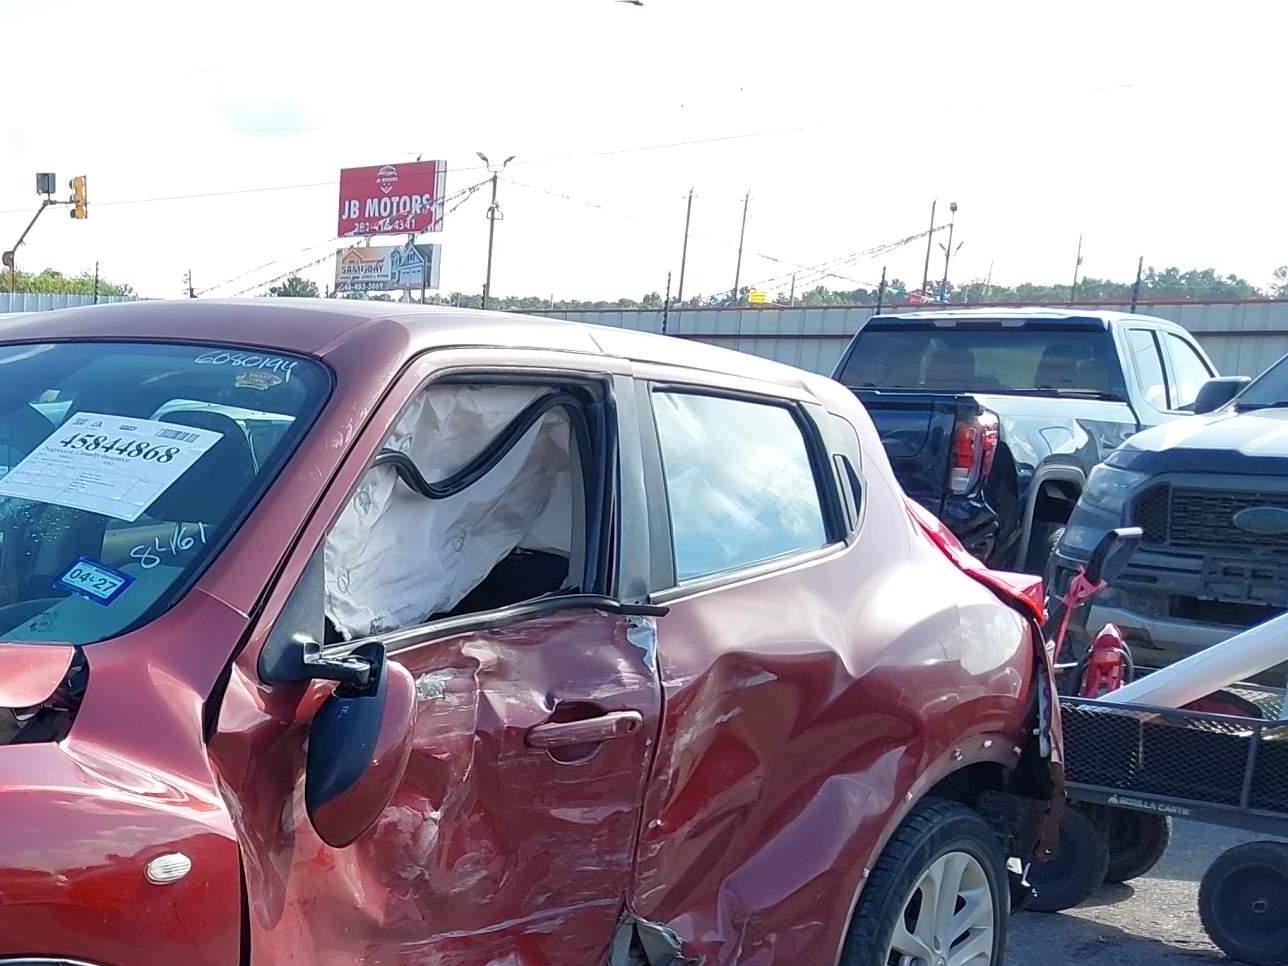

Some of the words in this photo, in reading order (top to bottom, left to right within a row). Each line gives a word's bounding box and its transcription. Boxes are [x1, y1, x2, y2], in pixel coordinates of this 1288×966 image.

[342, 199, 360, 220] JB
[365, 193, 430, 218] MOTORS
[59, 432, 180, 463] 45844868
